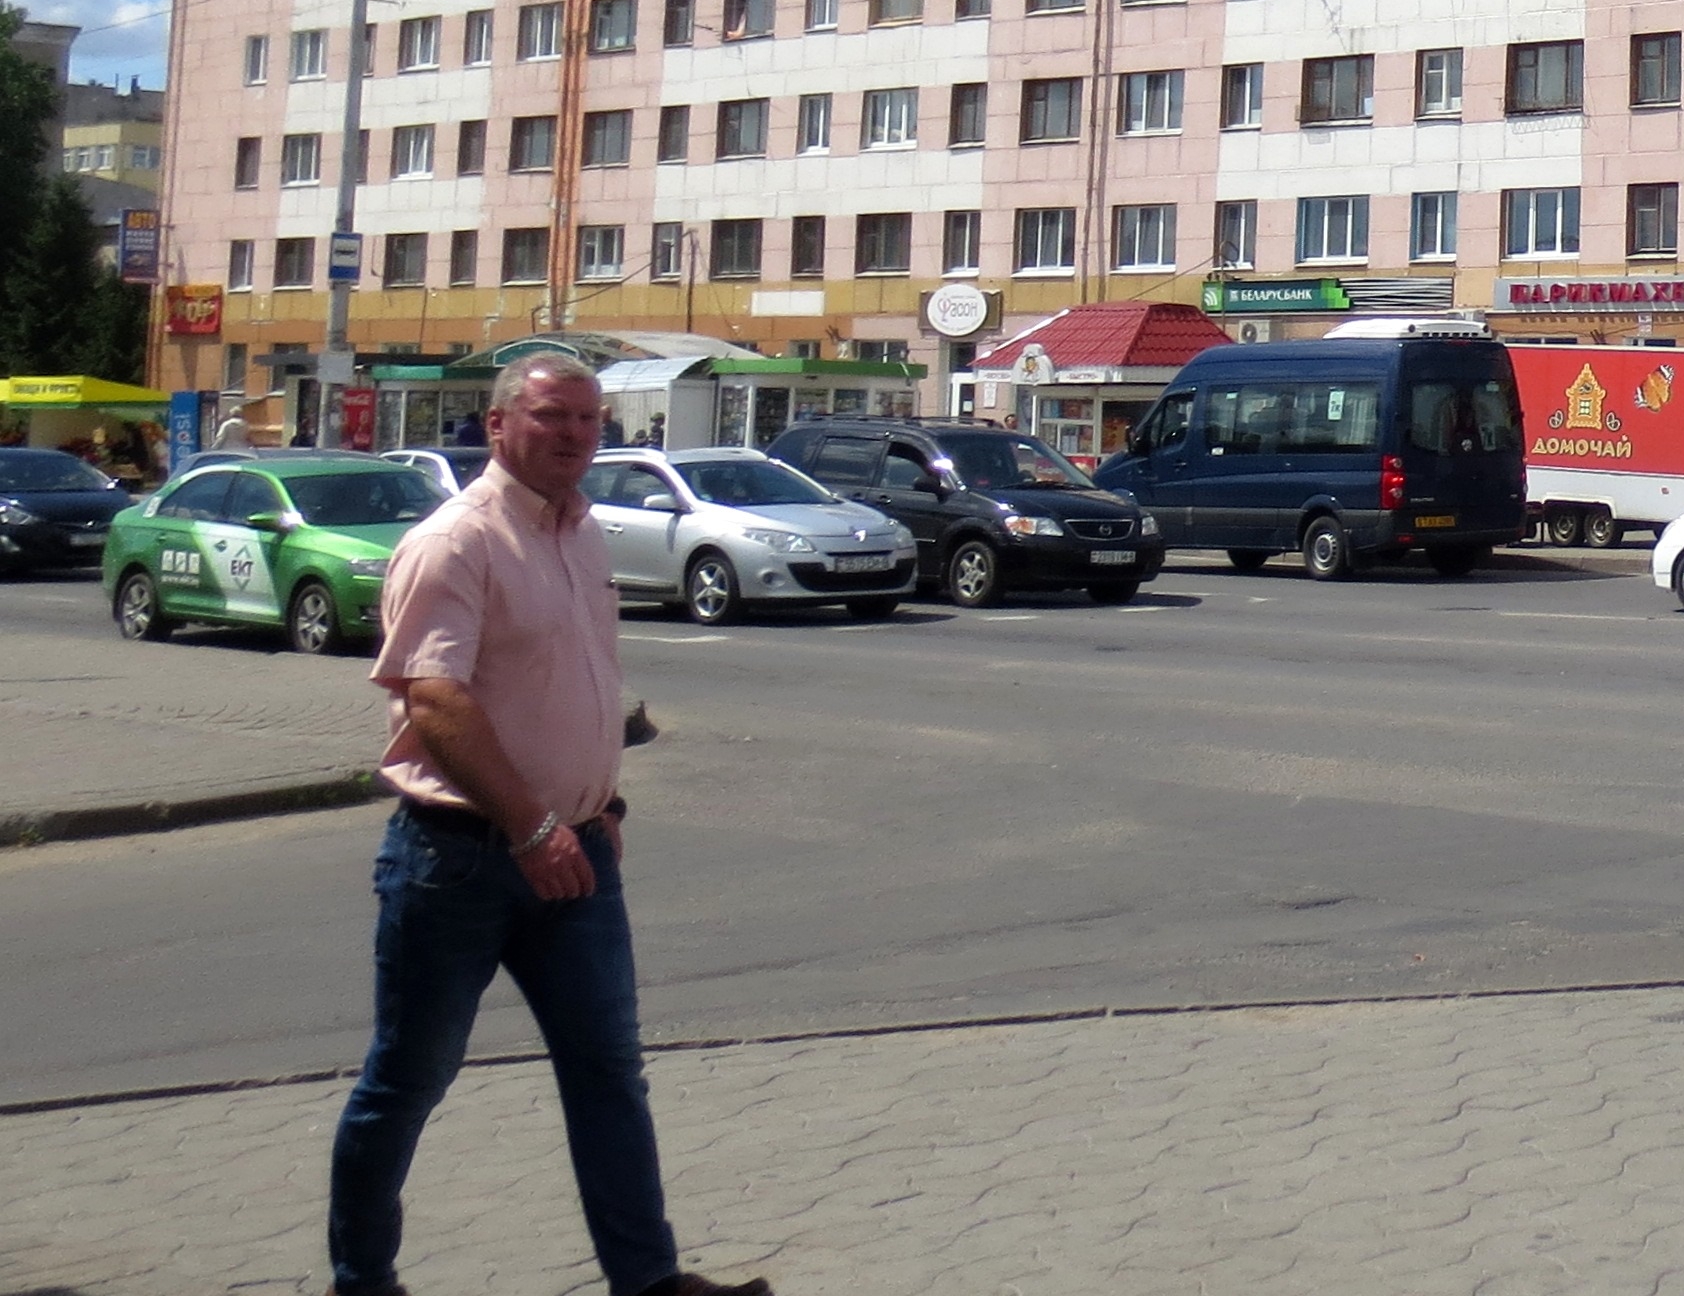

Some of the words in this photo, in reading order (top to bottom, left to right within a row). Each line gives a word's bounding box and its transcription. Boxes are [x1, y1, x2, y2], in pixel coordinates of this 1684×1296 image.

[1240, 288, 1312, 302] БЕЛАРУСБАНК
[177, 414, 195, 461] epsi
[1531, 434, 1632, 458] ДОМОЧАЙ
